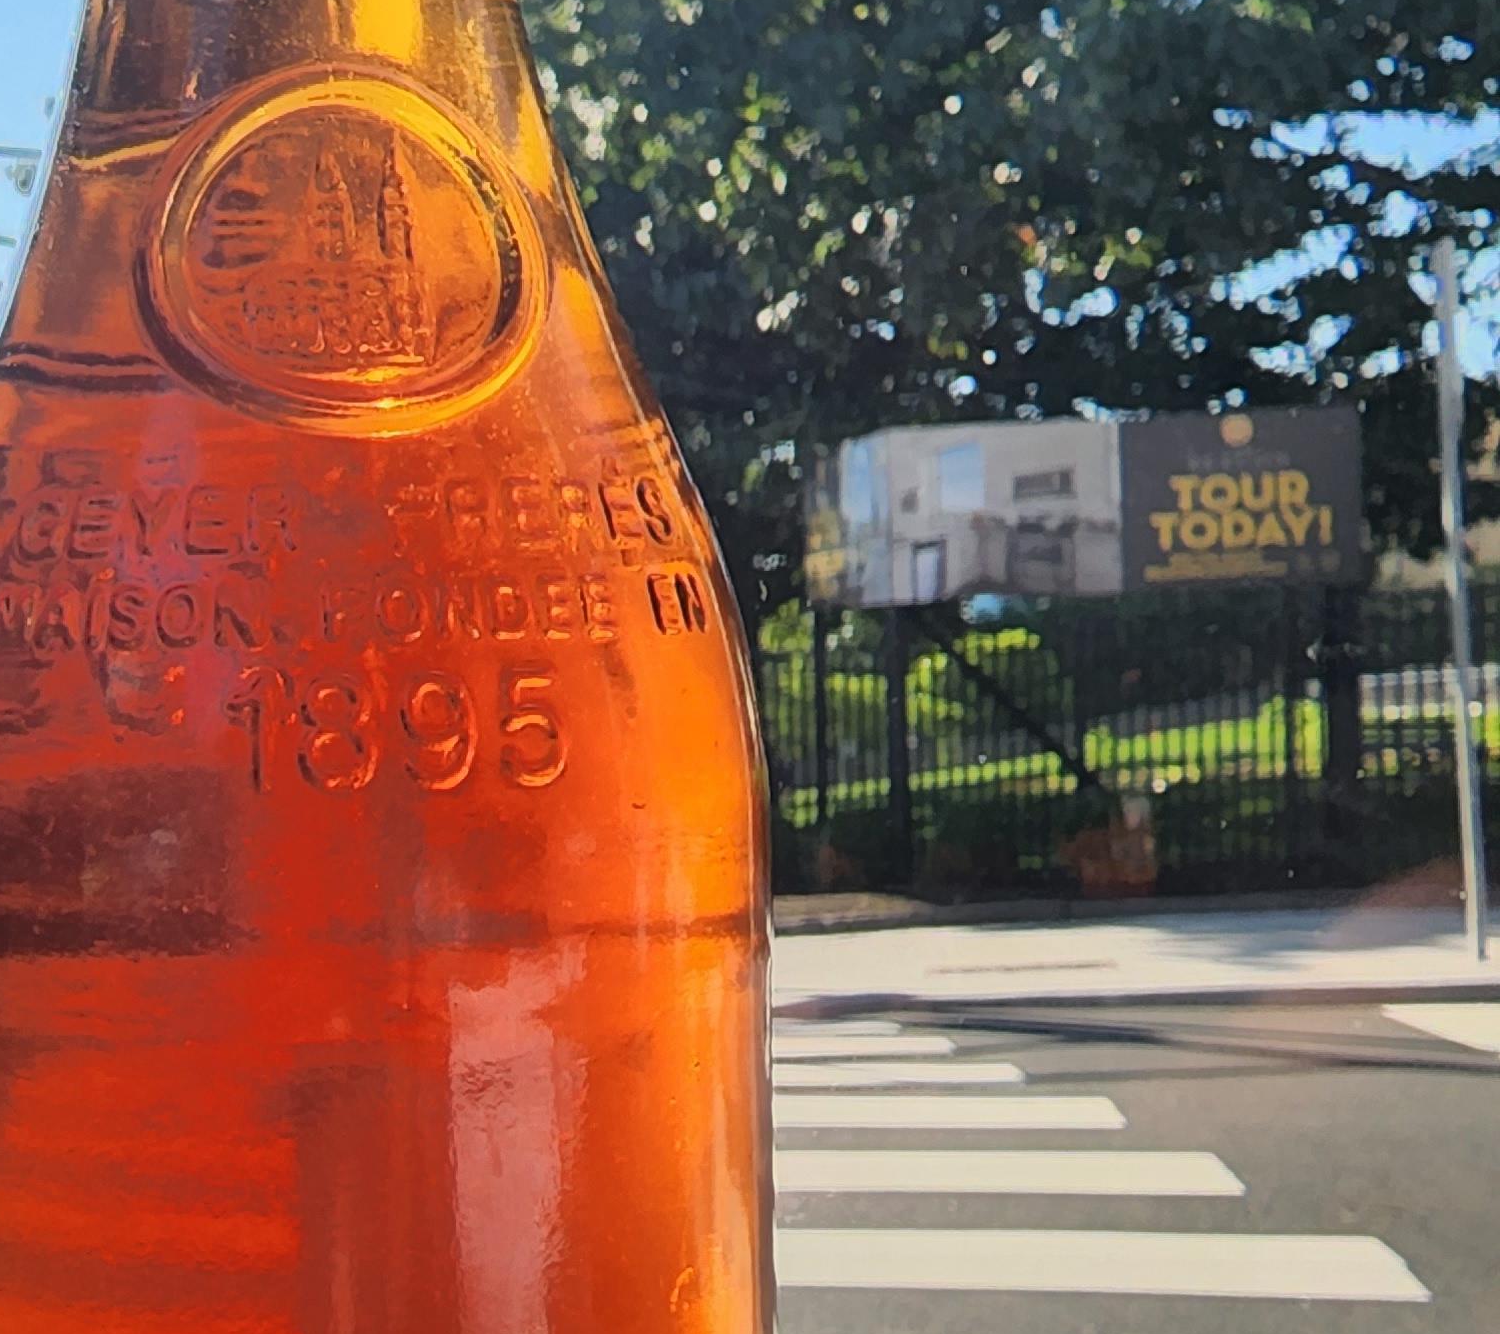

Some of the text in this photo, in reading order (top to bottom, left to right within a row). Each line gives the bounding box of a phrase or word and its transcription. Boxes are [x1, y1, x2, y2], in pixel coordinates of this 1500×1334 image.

[15, 484, 299, 563] GEYER
[1169, 470, 1309, 512] TOUR
[1150, 505, 1333, 551] TODAY!
[645, 571, 708, 637] EN
[224, 662, 568, 791] 1895
